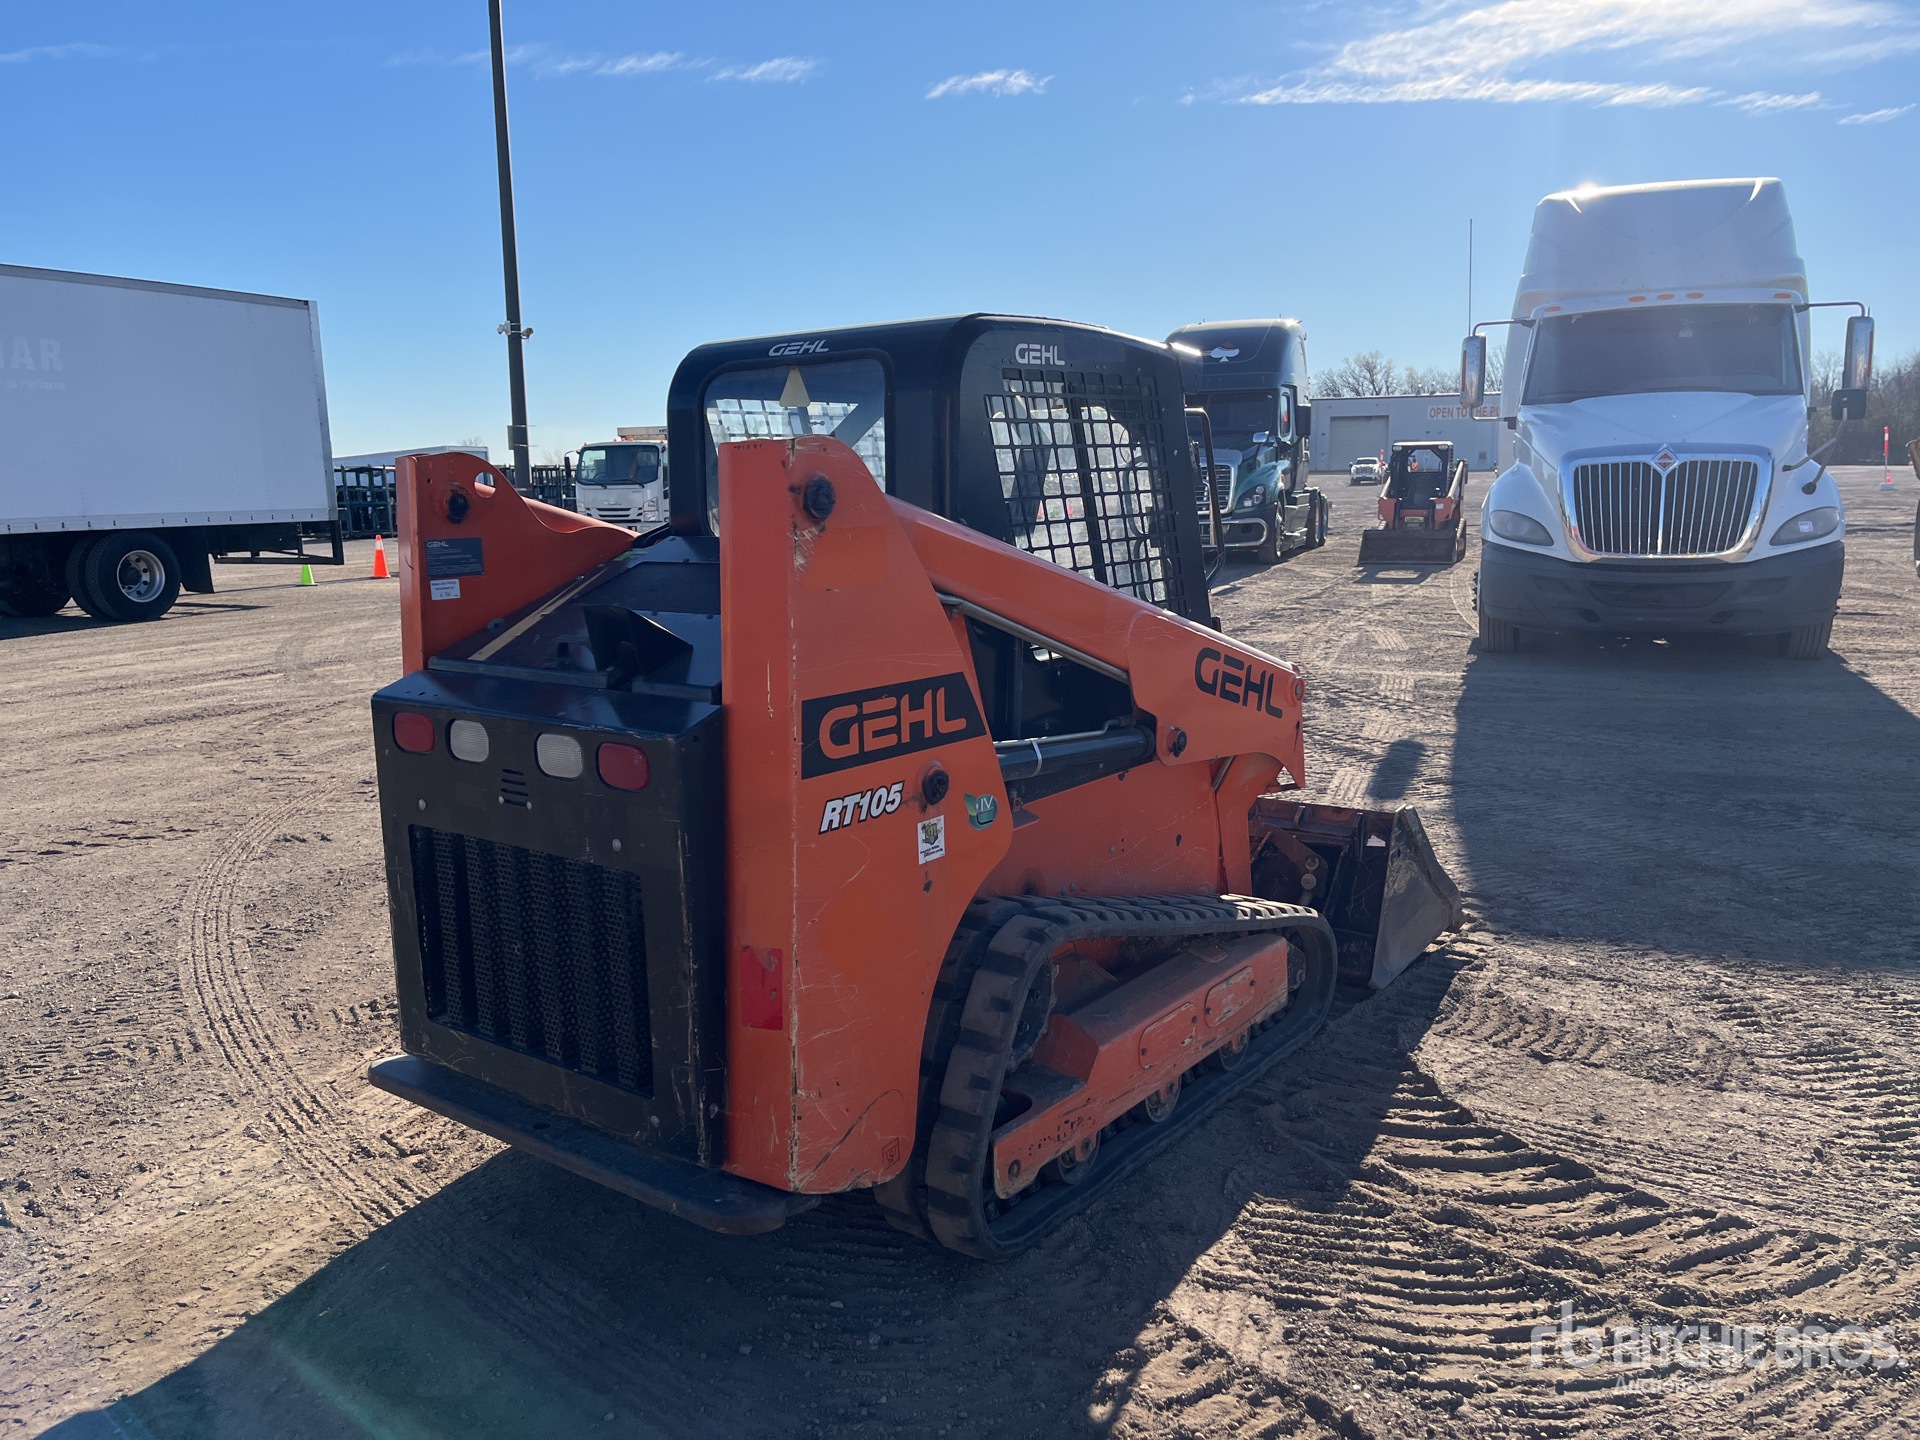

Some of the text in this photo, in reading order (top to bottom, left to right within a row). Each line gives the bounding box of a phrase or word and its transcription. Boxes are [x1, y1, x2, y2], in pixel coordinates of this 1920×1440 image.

[768, 339, 829, 357] GEHL
[1015, 343, 1065, 366] GEHL
[1429, 407, 1454, 418] OPEN
[1456, 407, 1468, 418] TO
[426, 541, 449, 549] GEHL
[1194, 647, 1283, 718] GEHL
[819, 686, 967, 760] GEHL
[818, 781, 905, 835] RT105
